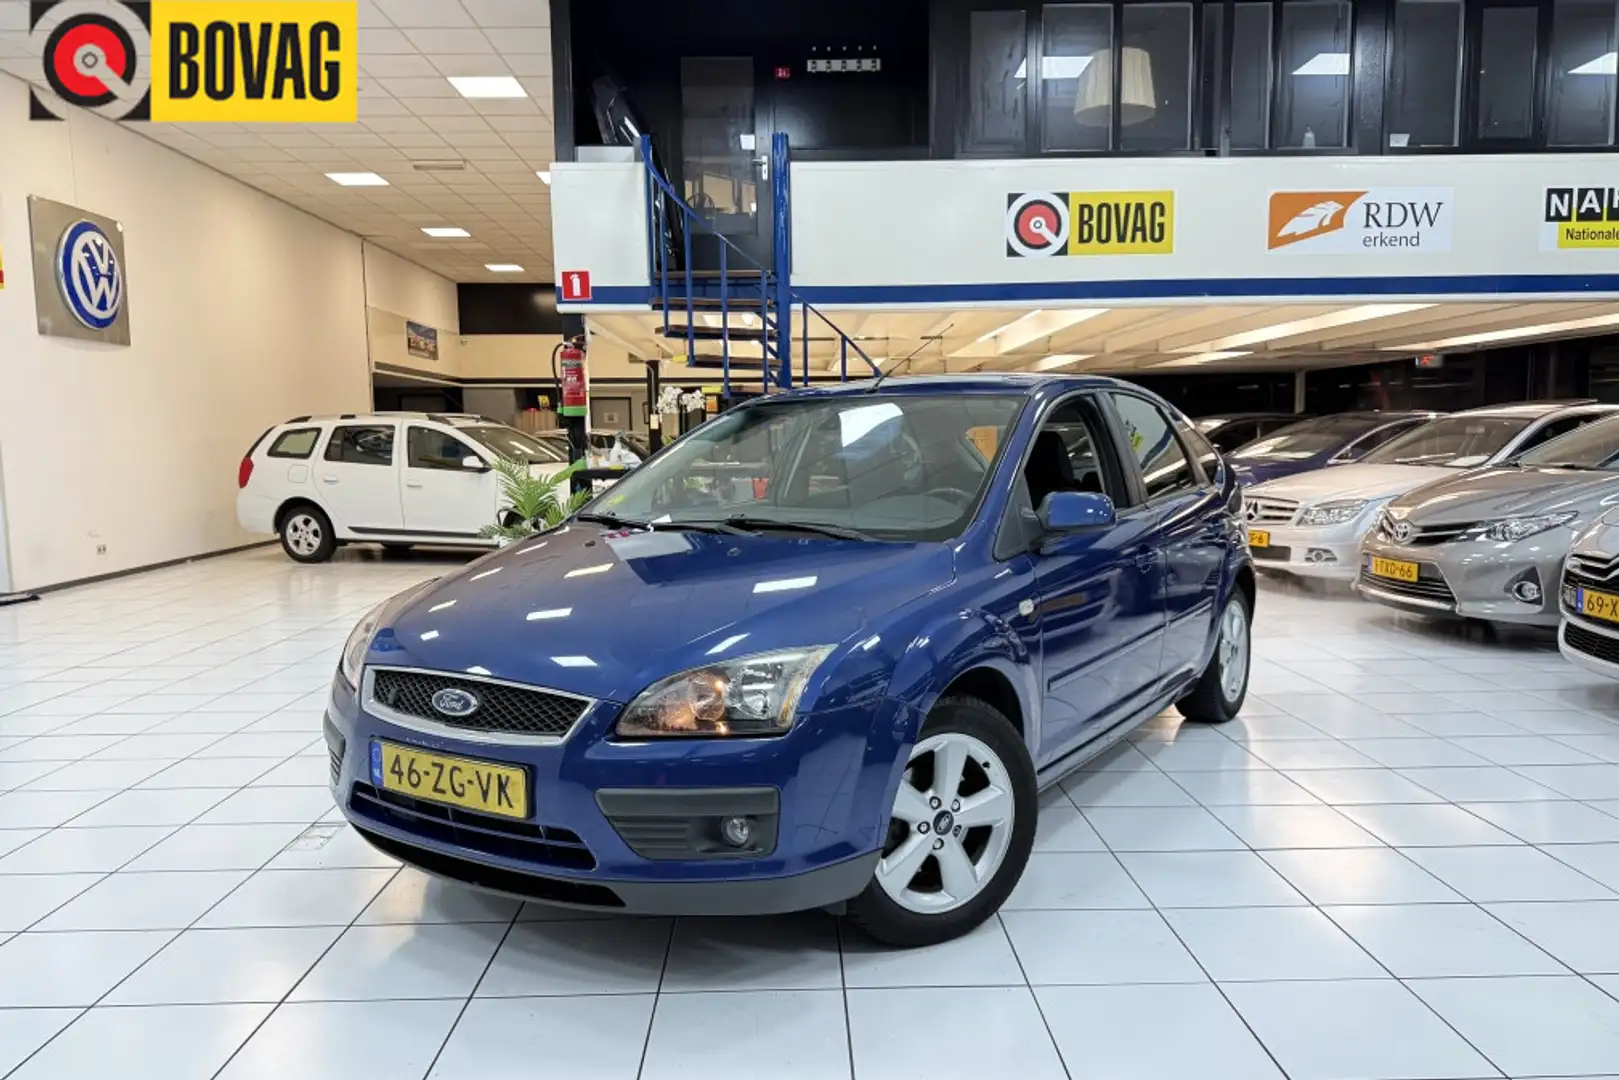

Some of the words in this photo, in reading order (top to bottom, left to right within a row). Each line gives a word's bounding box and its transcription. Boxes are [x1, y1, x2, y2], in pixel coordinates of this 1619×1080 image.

[1078, 201, 1166, 244] BOVAG
[1363, 202, 1444, 228] RDW
[1362, 231, 1420, 247] erkend
[390, 754, 514, 809] 46-ZG-VK
